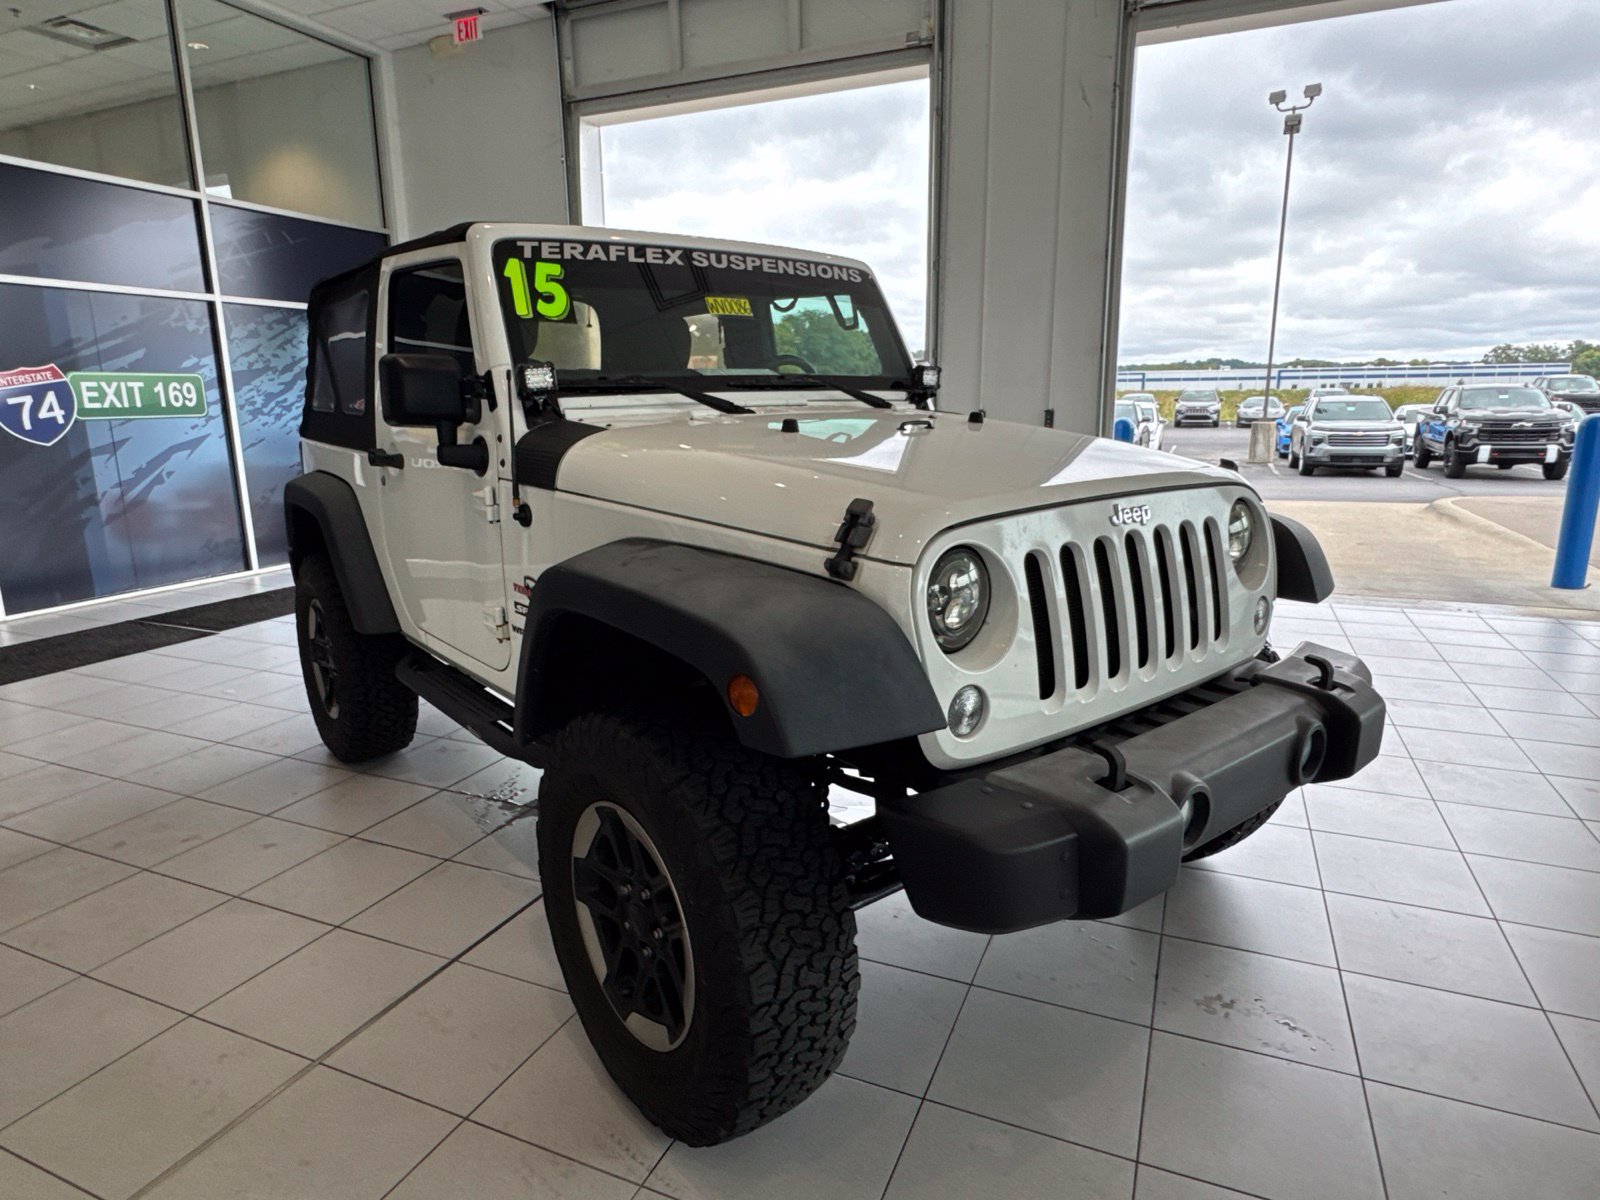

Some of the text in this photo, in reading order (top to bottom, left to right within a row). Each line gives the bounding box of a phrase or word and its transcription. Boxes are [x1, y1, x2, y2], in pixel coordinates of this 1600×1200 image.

[457, 16, 477, 42] EXIT
[516, 241, 863, 283] TERAFLEX SUSPENSIONS
[503, 257, 570, 321] 15
[6, 390, 65, 431] 74
[79, 381, 197, 409] EXIT 169
[1109, 503, 1151, 527] Jeep
